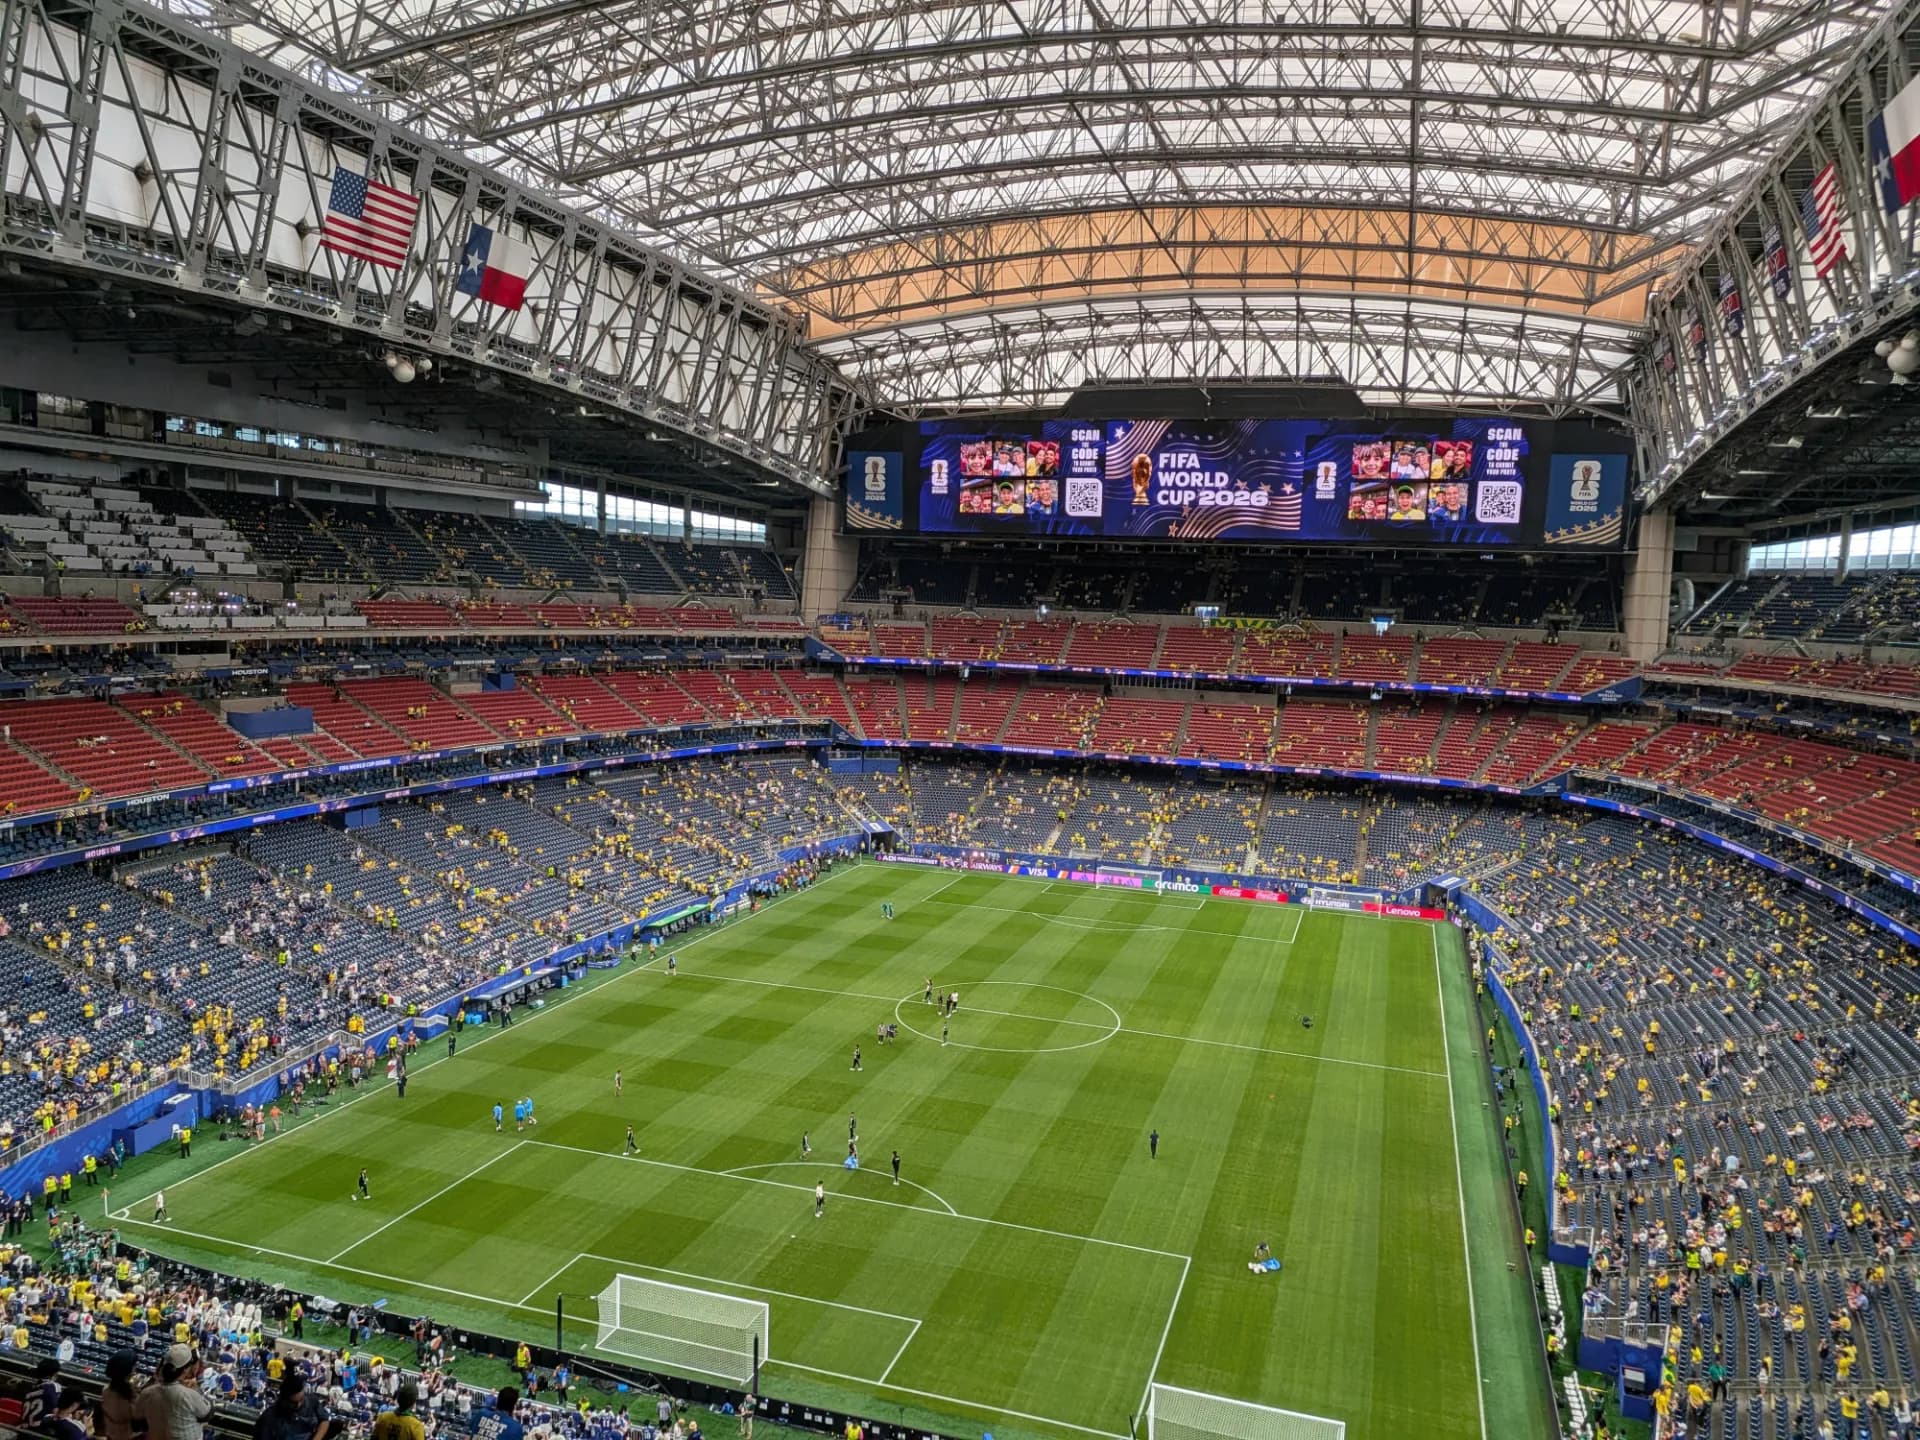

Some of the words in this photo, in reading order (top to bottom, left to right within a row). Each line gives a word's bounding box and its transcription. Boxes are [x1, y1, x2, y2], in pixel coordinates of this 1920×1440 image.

[1072, 429, 1100, 441] SCAN
[1487, 428, 1522, 441] SCAN
[1072, 448, 1099, 460] CODE
[1486, 448, 1520, 461] CODE
[1159, 453, 1201, 469] FIFA
[1158, 471, 1229, 488] WORLD
[1157, 490, 1196, 506] CUP
[1199, 490, 1269, 507] 2026
[231, 668, 268, 676] HOUSTON
[126, 793, 170, 806] HOUSTON
[84, 844, 121, 859] HOUSTON
[1027, 867, 1048, 876] VISA
[1154, 881, 1199, 893] aramco
[1386, 906, 1421, 917] Lenovo
[22, 1399, 43, 1427] 22
[479, 1416, 508, 1434] BEST
